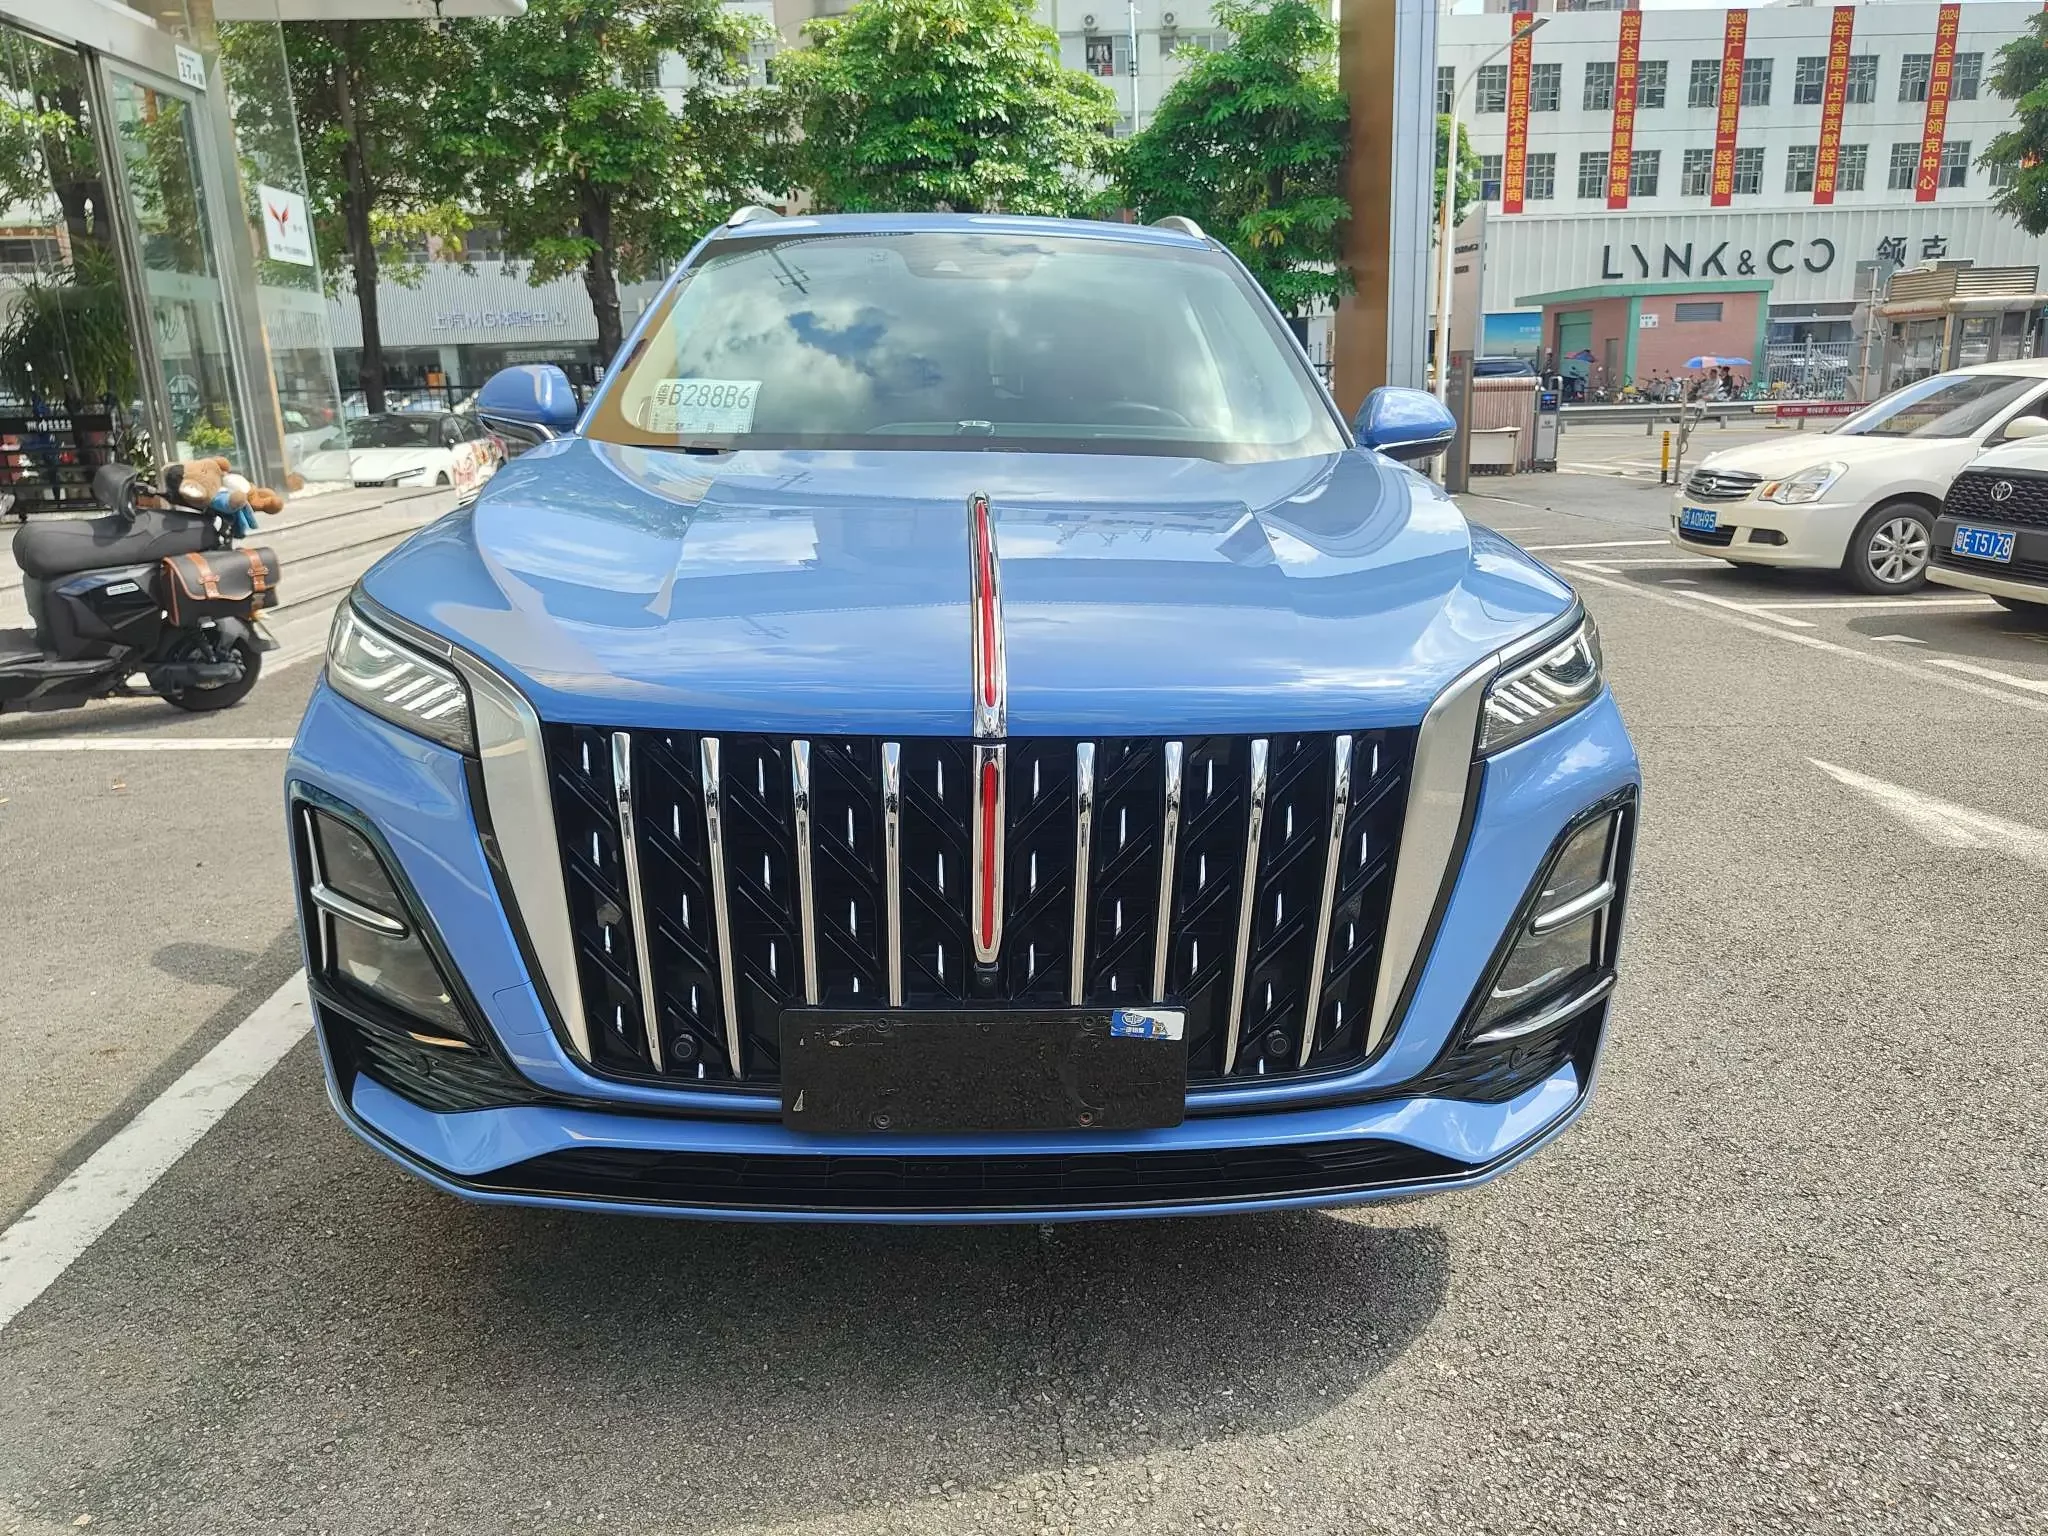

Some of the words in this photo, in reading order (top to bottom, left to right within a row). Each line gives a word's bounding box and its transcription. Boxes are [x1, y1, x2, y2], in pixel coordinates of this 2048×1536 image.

[1610, 16, 1640, 197] 2024年全国十佳销量经销商
[1714, 13, 1746, 195] 2024年广东省销量第一经销商
[1919, 9, 1958, 190] 2024年全国四星领克中心
